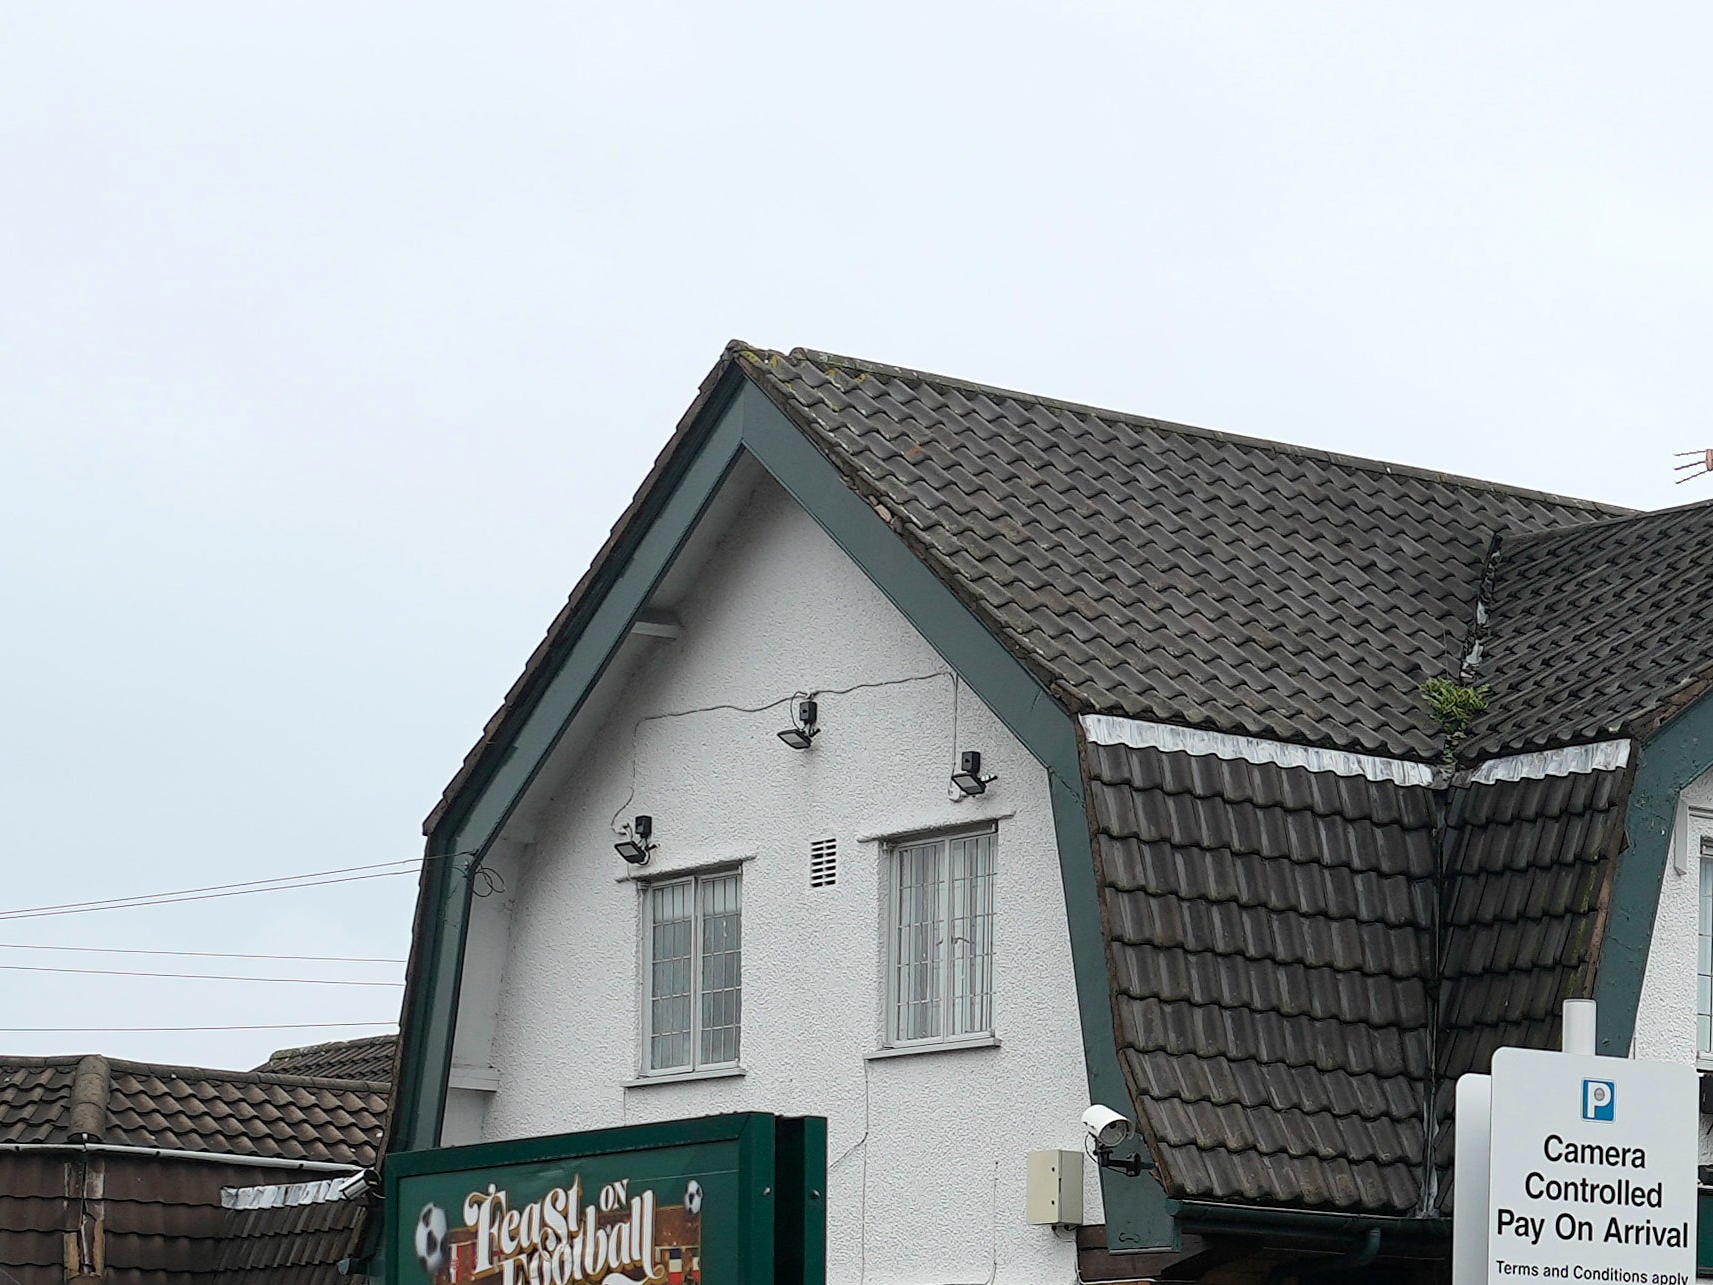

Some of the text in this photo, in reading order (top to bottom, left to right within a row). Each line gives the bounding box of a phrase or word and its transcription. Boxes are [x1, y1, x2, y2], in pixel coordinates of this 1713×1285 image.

[1586, 1081, 1612, 1119] P
[1543, 1134, 1647, 1169] Camera
[598, 1178, 630, 1213] ON
[1524, 1172, 1663, 1208] Controlled
[464, 1174, 583, 1274] Feast
[1497, 1208, 1688, 1249] Pay On Arrival
[1496, 1260, 1540, 1278] Terms
[1543, 1264, 1569, 1279] and
[1573, 1265, 1649, 1285] Conditions
